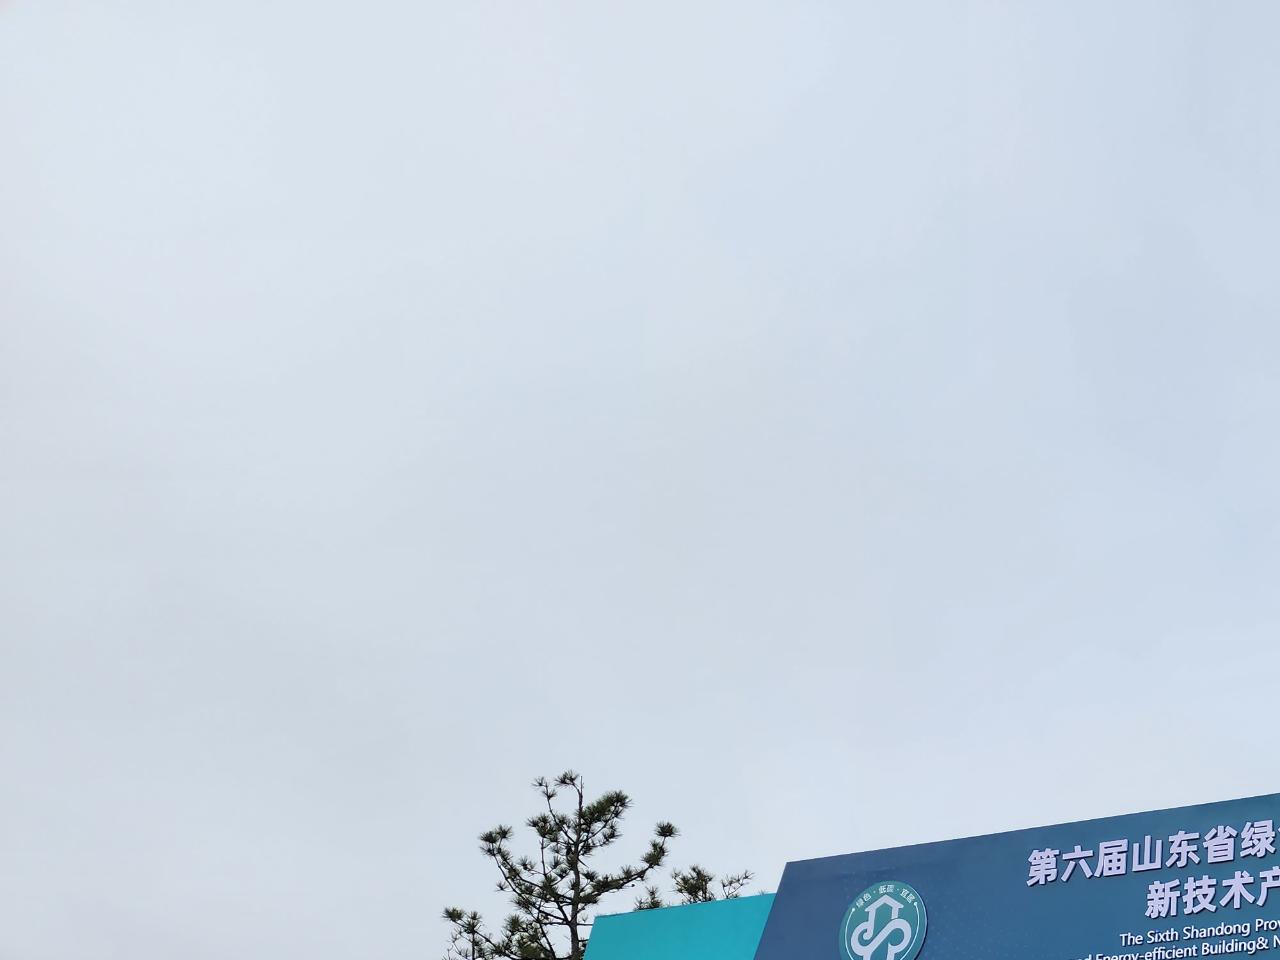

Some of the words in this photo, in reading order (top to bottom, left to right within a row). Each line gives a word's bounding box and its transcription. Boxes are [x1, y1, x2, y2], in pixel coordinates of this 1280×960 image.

[1120, 933, 1143, 947] The
[1147, 928, 1179, 944] Sixth
[1183, 921, 1250, 941] Shandong
[1202, 935, 1268, 956] Building&
